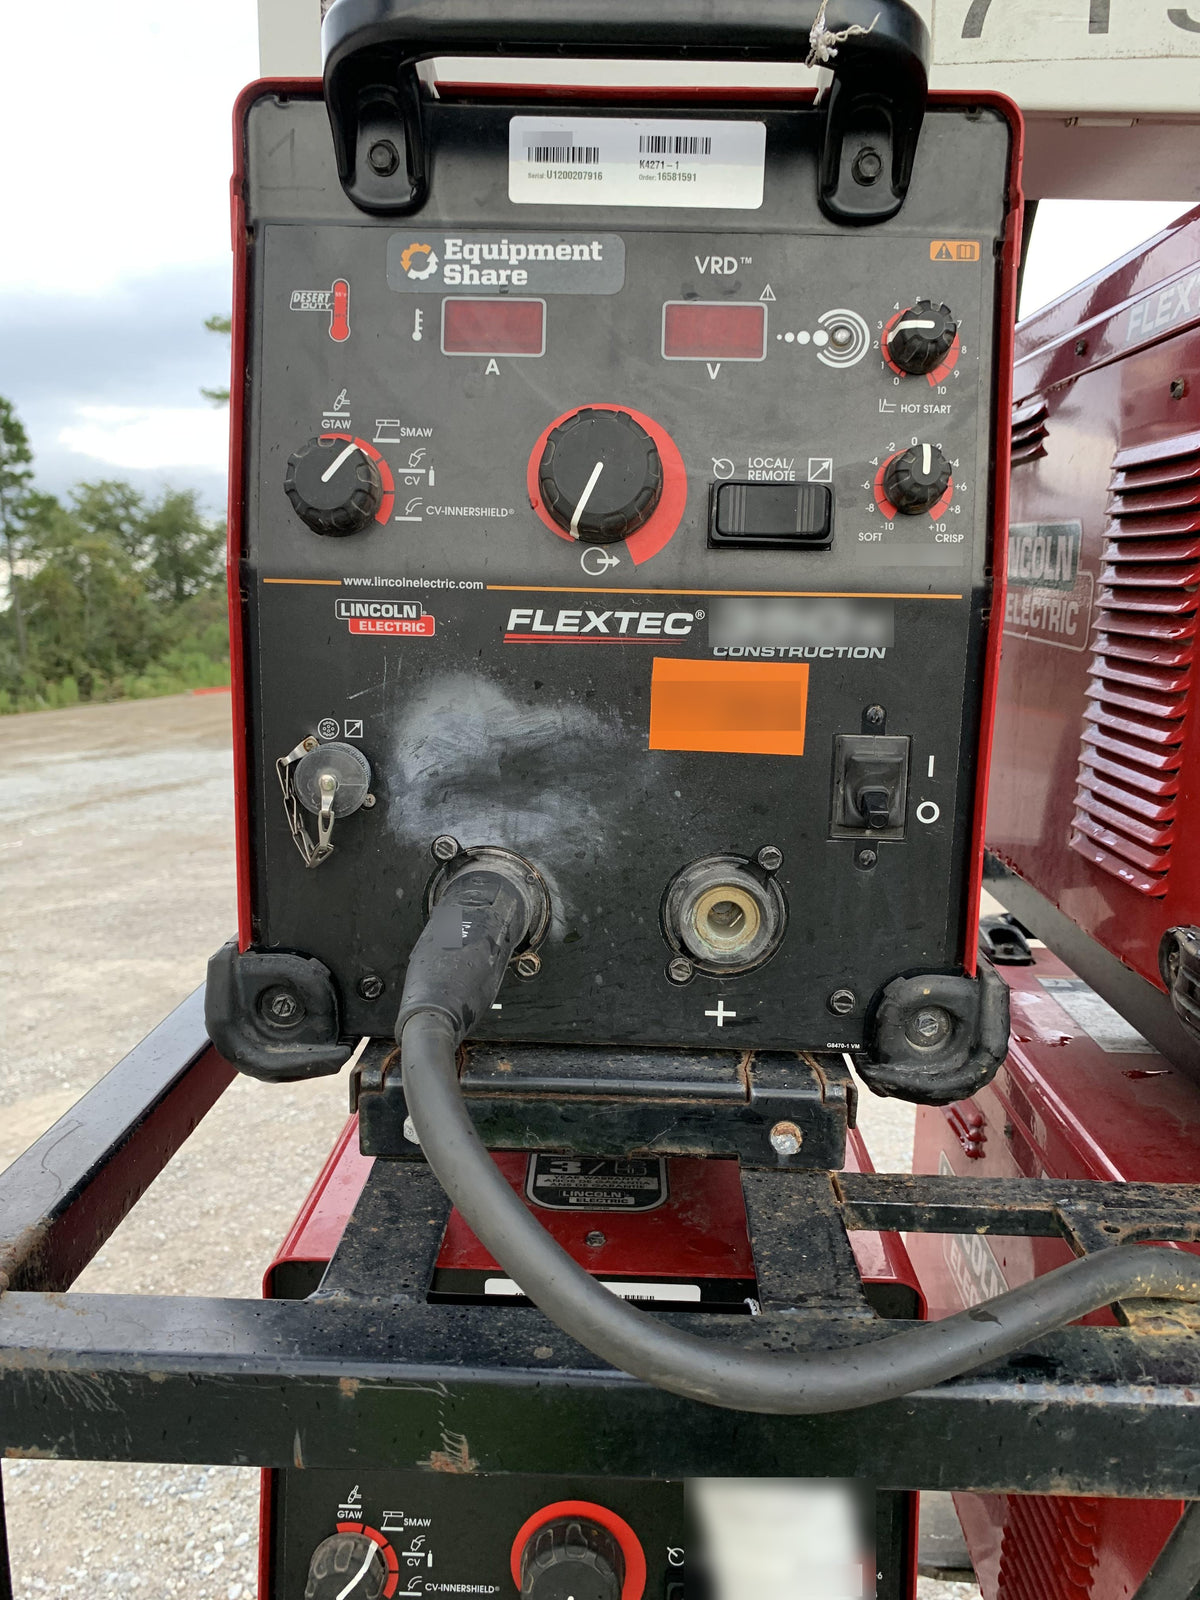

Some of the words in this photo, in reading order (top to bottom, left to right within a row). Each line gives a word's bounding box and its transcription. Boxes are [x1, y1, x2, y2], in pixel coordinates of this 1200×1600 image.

[546, 170, 603, 181] U1200207916
[657, 172, 697, 182] 16581591
[444, 239, 603, 264] Equipment
[443, 264, 528, 286] Share
[293, 292, 331, 303] DESERT
[893, 302, 900, 310] 4
[877, 321, 883, 329] 3
[873, 341, 879, 349] 2
[961, 345, 967, 354] 8
[485, 359, 500, 376] A
[706, 363, 721, 380] V
[954, 369, 960, 378] 9
[937, 386, 947, 395] 10
[900, 404, 921, 414] HOT
[923, 405, 952, 414] START
[321, 419, 352, 430] GTAW
[400, 427, 433, 438] SMAW
[747, 457, 794, 469] LOCAL/
[404, 476, 420, 486] CV
[747, 470, 796, 482] REMOTE
[955, 482, 967, 492] +6
[948, 505, 961, 514] +8
[928, 523, 947, 532] +10
[858, 532, 883, 542] SOFT
[935, 534, 964, 543] CRISP
[1007, 534, 1075, 582] NCOLN
[343, 577, 484, 590] www.lincolnelectric.com
[340, 602, 417, 619] LINCOLN
[1005, 592, 1079, 636] ELECTRIC
[359, 620, 426, 633] ELECTRIC
[713, 646, 887, 660] CONSTRUCTION
[562, 1190, 622, 1198] LINCOLN
[337, 1510, 363, 1519] GTAW
[403, 1518, 431, 1527] SMAW
[406, 1558, 421, 1566] CV
